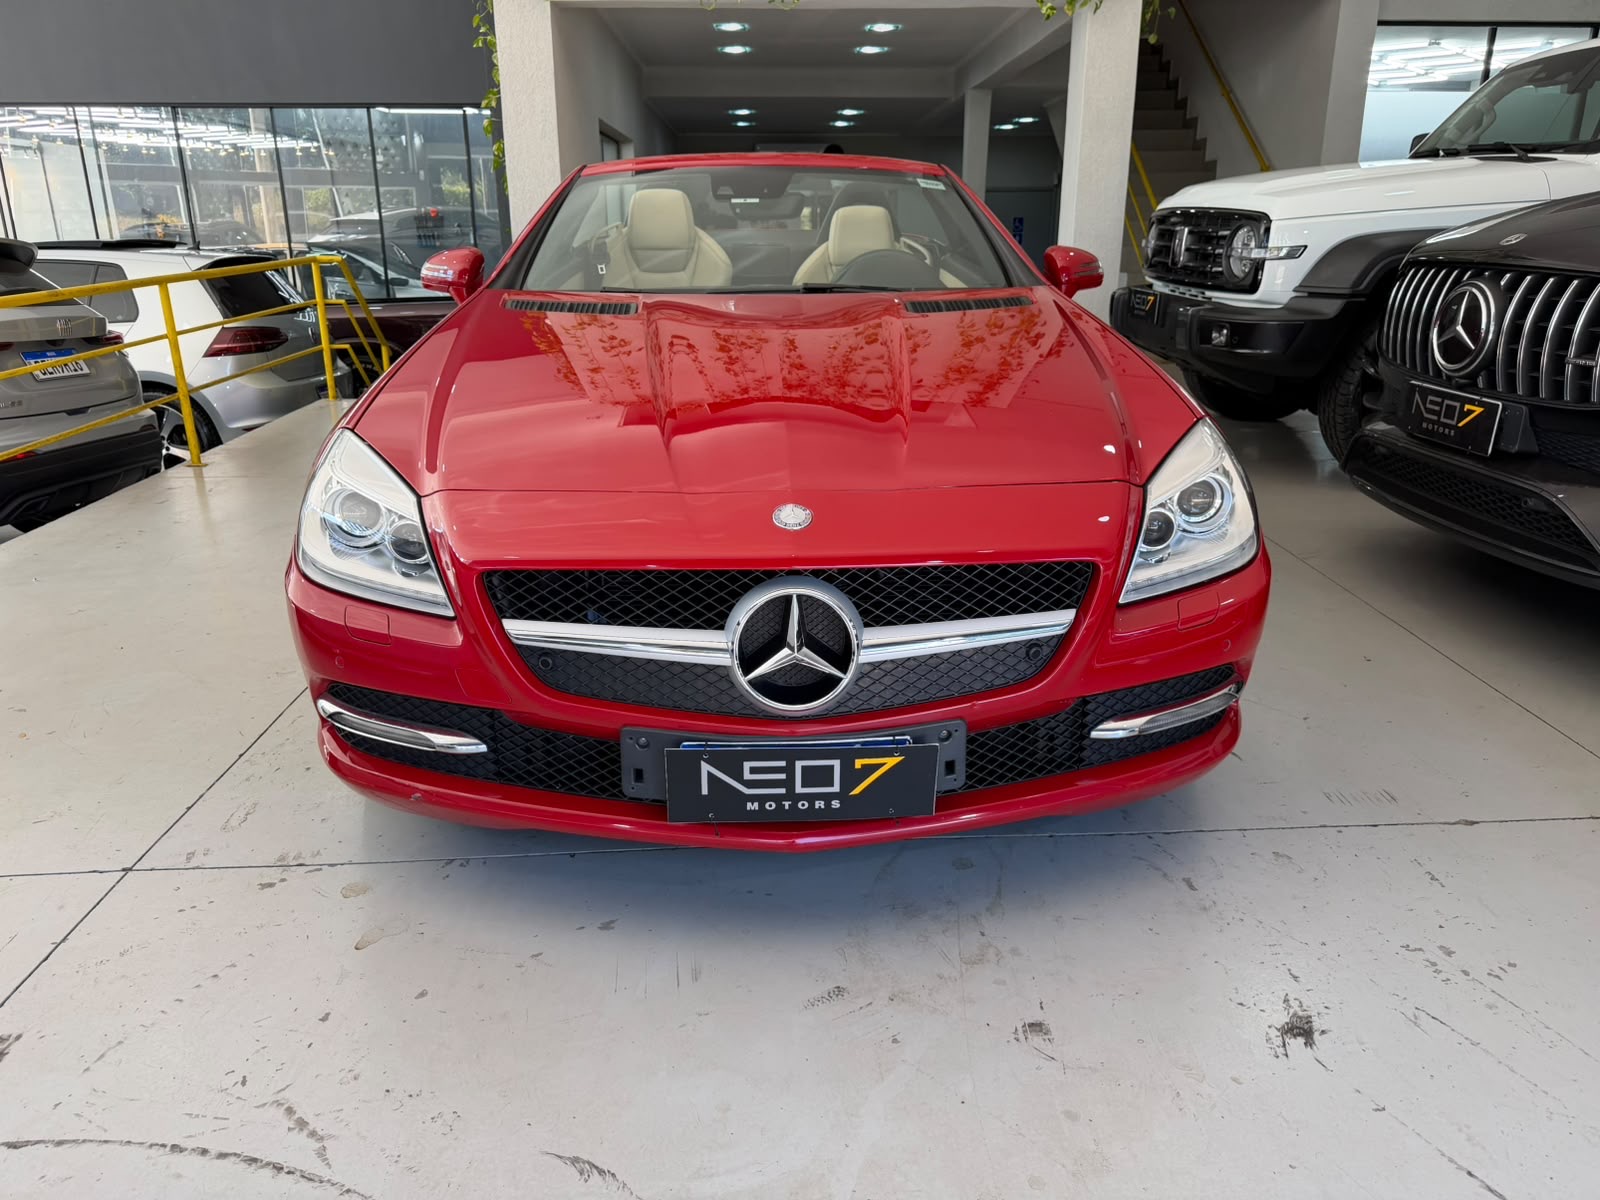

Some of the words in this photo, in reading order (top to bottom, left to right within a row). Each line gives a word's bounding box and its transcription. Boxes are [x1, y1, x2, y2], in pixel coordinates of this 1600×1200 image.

[1412, 390, 1485, 427] NEO7
[1422, 421, 1455, 437] MOTORS
[700, 756, 905, 795] NEO7
[746, 799, 841, 811] MOTORS
